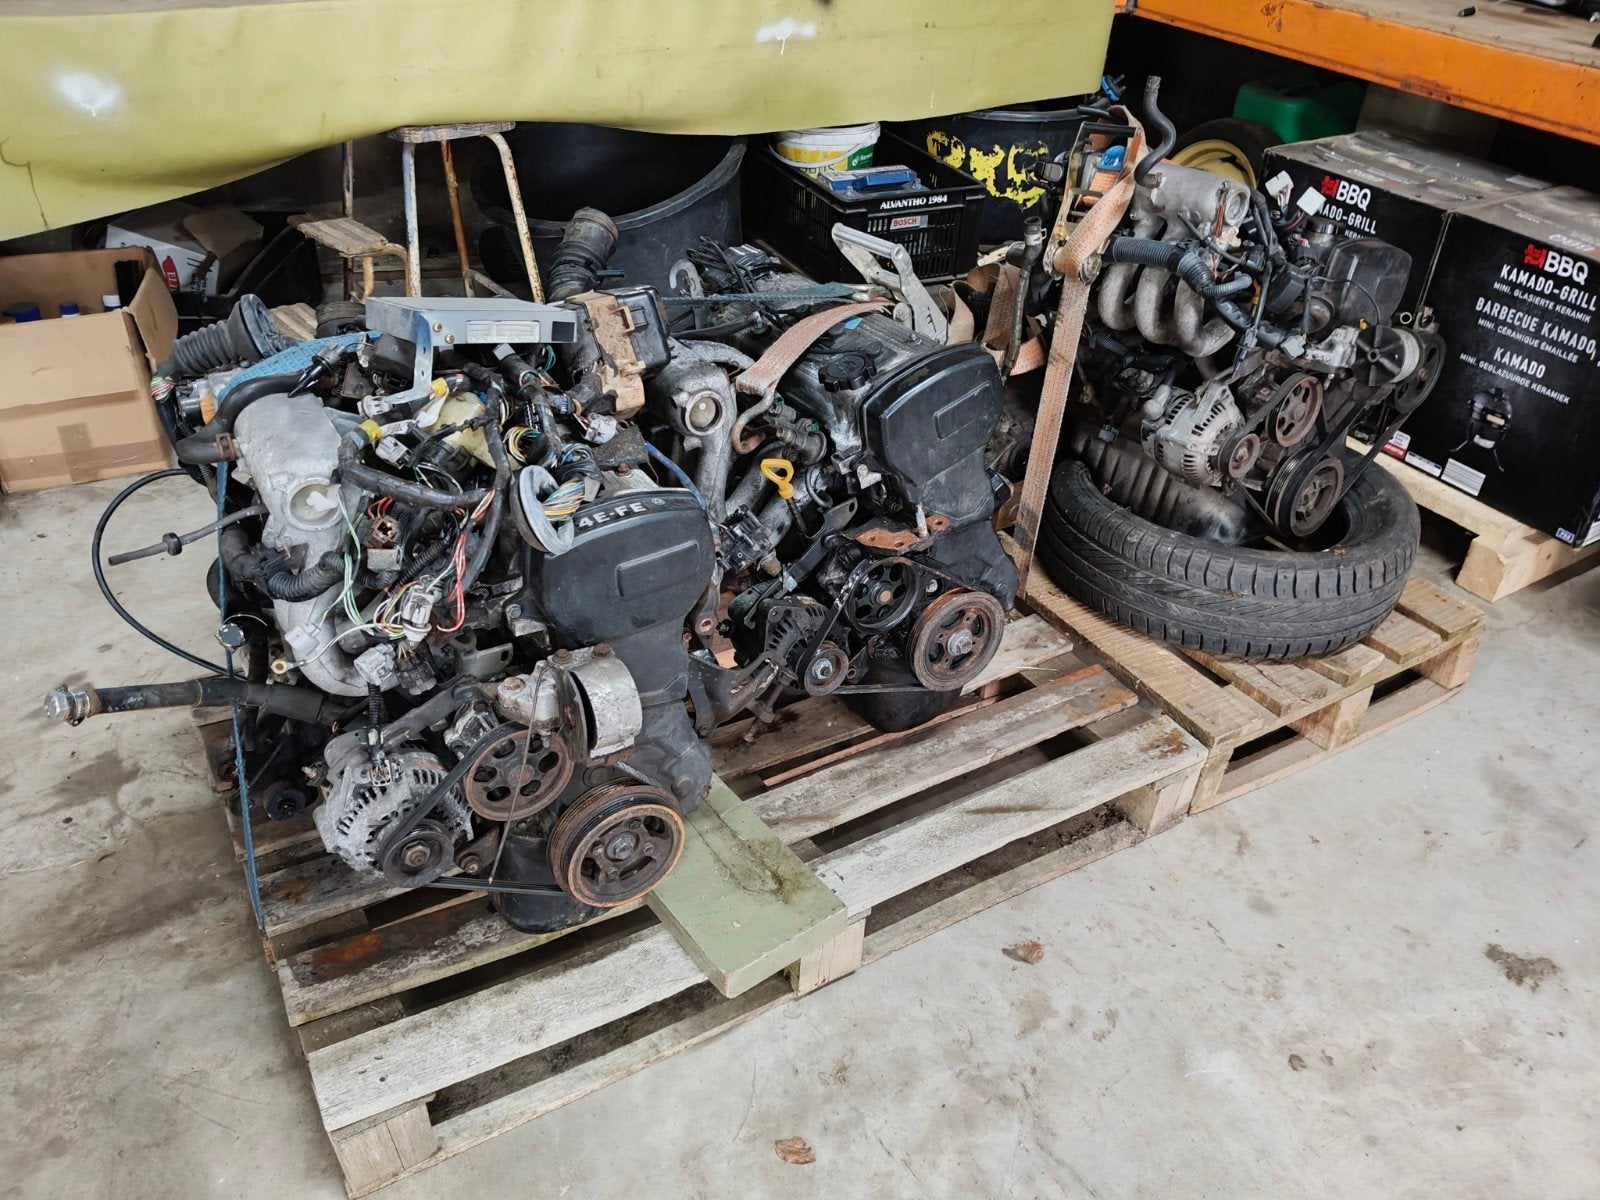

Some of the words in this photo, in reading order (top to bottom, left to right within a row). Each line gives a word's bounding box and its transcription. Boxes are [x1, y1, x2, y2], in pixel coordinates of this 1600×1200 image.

[880, 196, 926, 210] ALVANTHO
[928, 194, 948, 205] 1984
[1336, 180, 1371, 212] BBQ
[893, 217, 917, 227] BOSCH
[1543, 250, 1589, 286] BBQ
[1500, 263, 1597, 312] KAMADO-GRILL
[1513, 289, 1555, 311] GLASIERTE
[1555, 304, 1592, 324] KERAMIK
[1475, 296, 1540, 333] BARBECUE
[1541, 321, 1597, 354] KAMADO
[1497, 325, 1540, 348] CÉRAMIQUE
[1540, 341, 1579, 364] ÉMAILLÉE
[1493, 346, 1547, 379] KAMADO
[1478, 360, 1530, 388] GEGLAZUURDE
[1531, 382, 1571, 405] KERAMIEK
[578, 502, 647, 528] 4E-FE
